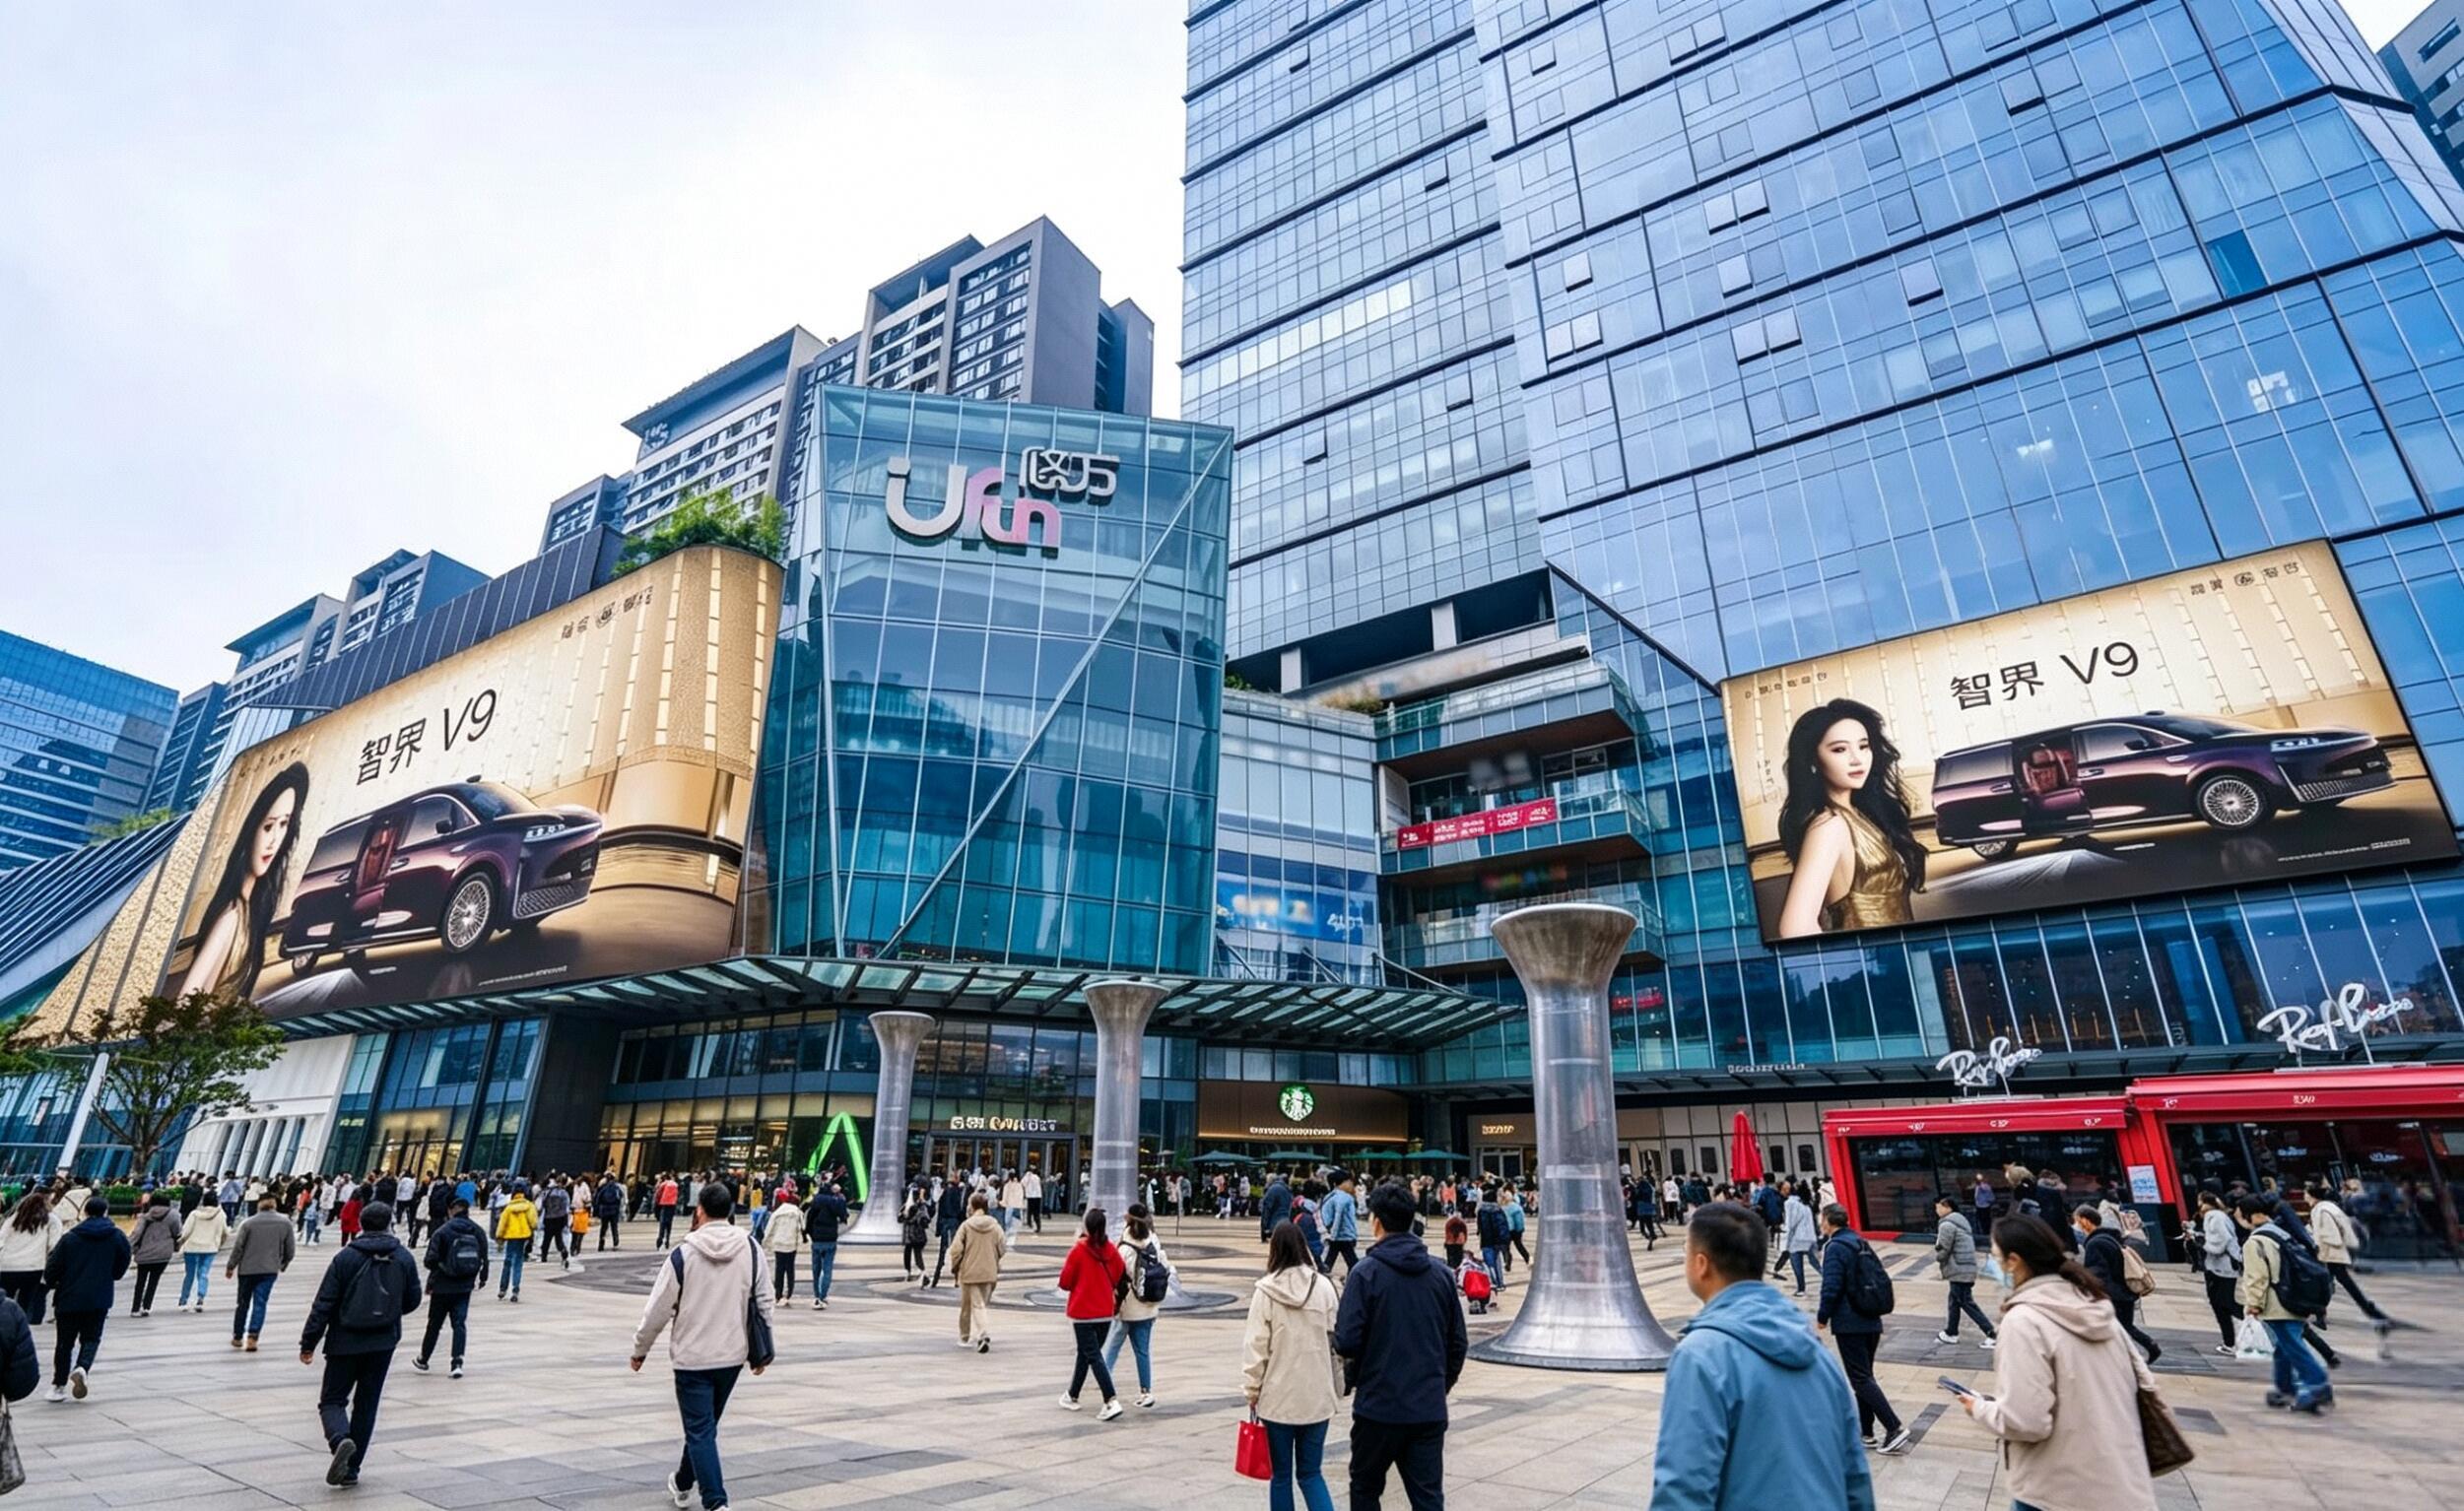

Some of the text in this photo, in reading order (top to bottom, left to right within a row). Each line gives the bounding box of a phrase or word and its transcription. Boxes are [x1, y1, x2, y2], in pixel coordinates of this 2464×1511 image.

[1950, 641, 2139, 710] 智界 V9
[357, 717, 427, 785] 智界
[443, 689, 497, 751] V9
